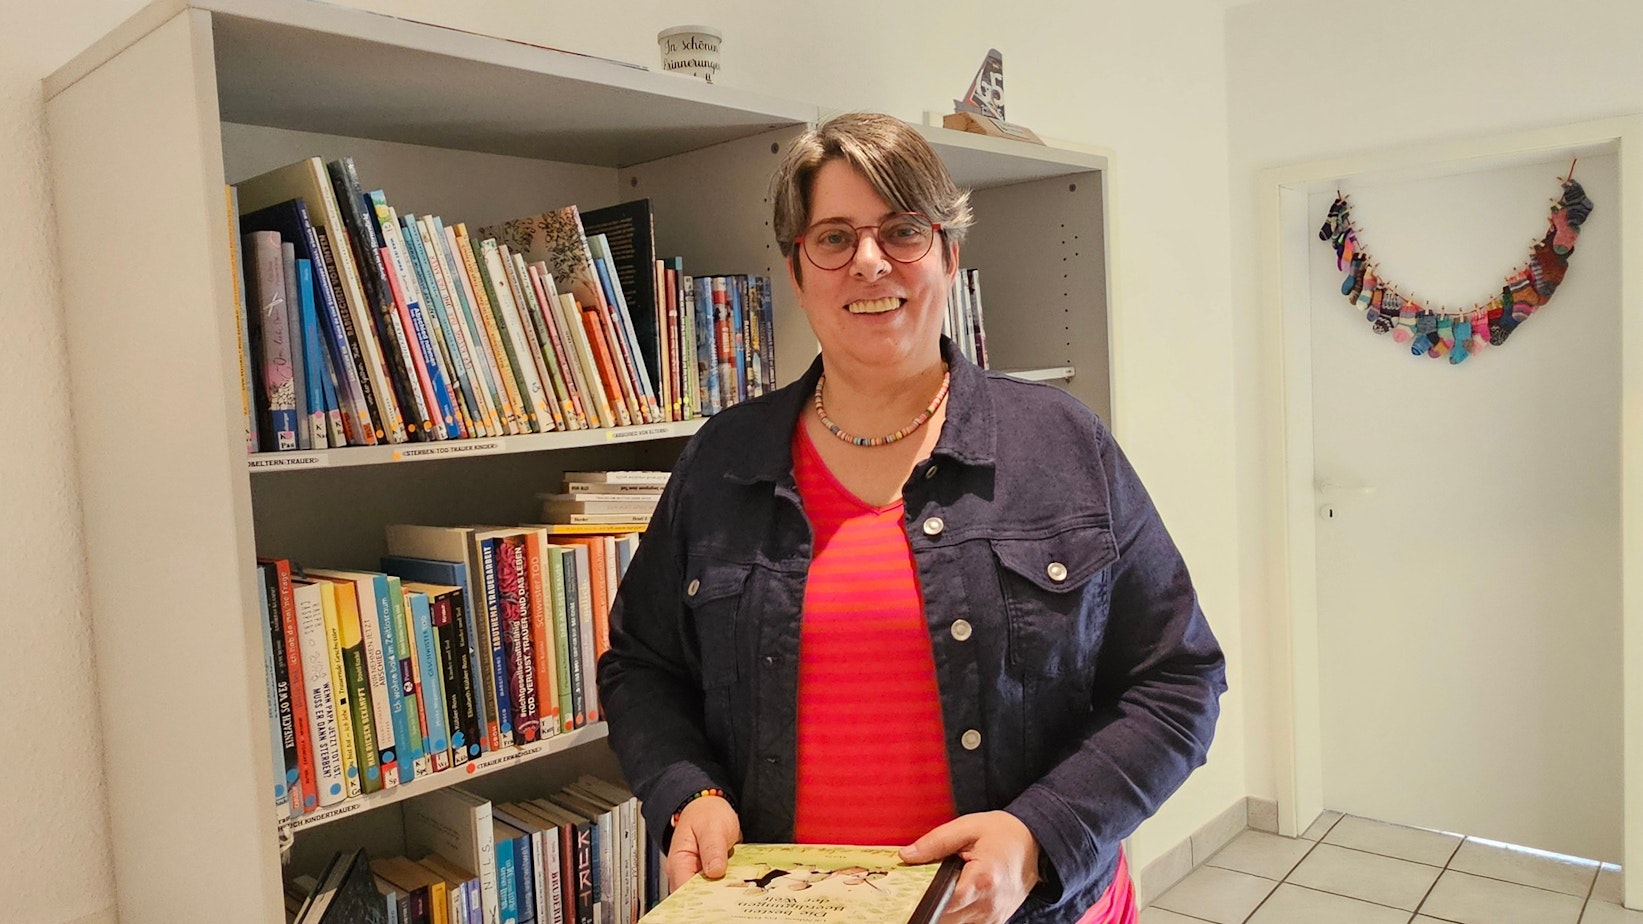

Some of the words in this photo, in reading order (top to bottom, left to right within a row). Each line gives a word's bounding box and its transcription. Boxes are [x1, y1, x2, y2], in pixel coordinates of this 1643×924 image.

[317, 234, 331, 264] UNTEN
[326, 264, 337, 285] VON
[332, 285, 353, 337] RADIESCHEN
[411, 306, 430, 340] Abschied
[422, 339, 438, 367] nehmen
[743, 319, 752, 362] RATATOUILLE
[513, 546, 524, 576] LEBEN
[529, 556, 540, 577] TOD
[483, 545, 496, 604] TRAUERARBEIT
[516, 576, 526, 596] DAS
[554, 563, 564, 589] TRAUER
[518, 595, 528, 616] UND
[531, 578, 546, 628] Schwester
[557, 590, 565, 604] DER
[284, 608, 292, 623] mal
[299, 599, 314, 635] CASPERS
[380, 596, 393, 643] Zeitlosraum
[558, 606, 566, 621] ABC
[286, 624, 293, 635] da
[362, 618, 373, 640] JETZT
[489, 604, 501, 651] TABUTHEMA
[520, 616, 531, 652] TRAUER
[559, 622, 567, 637] DAS
[287, 636, 295, 652] hab
[329, 626, 341, 663] Geschwister
[364, 639, 379, 674] NEHMEN
[386, 644, 394, 654] im
[372, 648, 387, 686] ABSCHIED
[387, 654, 397, 672] bald
[460, 653, 471, 690] Kübler-Ross
[511, 620, 528, 717] #nichtgesellschaftsfähig
[277, 680, 289, 701] WEG
[334, 664, 345, 694] Trauernde
[370, 674, 380, 688] WIR
[389, 672, 400, 698] wohne
[312, 687, 323, 709] MUSS
[321, 681, 332, 703] WENN
[354, 686, 370, 723] BEKÄMPFT
[464, 689, 474, 718] Elisabeth
[279, 701, 290, 713] SO
[315, 709, 324, 720] ER
[324, 704, 334, 724] PAPA
[392, 699, 402, 713] Ich
[450, 693, 460, 729] Kübler-Ross
[280, 713, 294, 748] EINFACH
[316, 721, 327, 741] DANN
[327, 725, 337, 747] JETZT
[360, 722, 374, 751] RIESEN
[318, 742, 333, 778] STERBEN?
[330, 748, 340, 763] TOT
[331, 764, 341, 779] IST,
[519, 845, 531, 890] verwitwet
[578, 829, 592, 906] KURT
[523, 891, 534, 916] Jung
[738, 902, 844, 911] Beerdigungen
